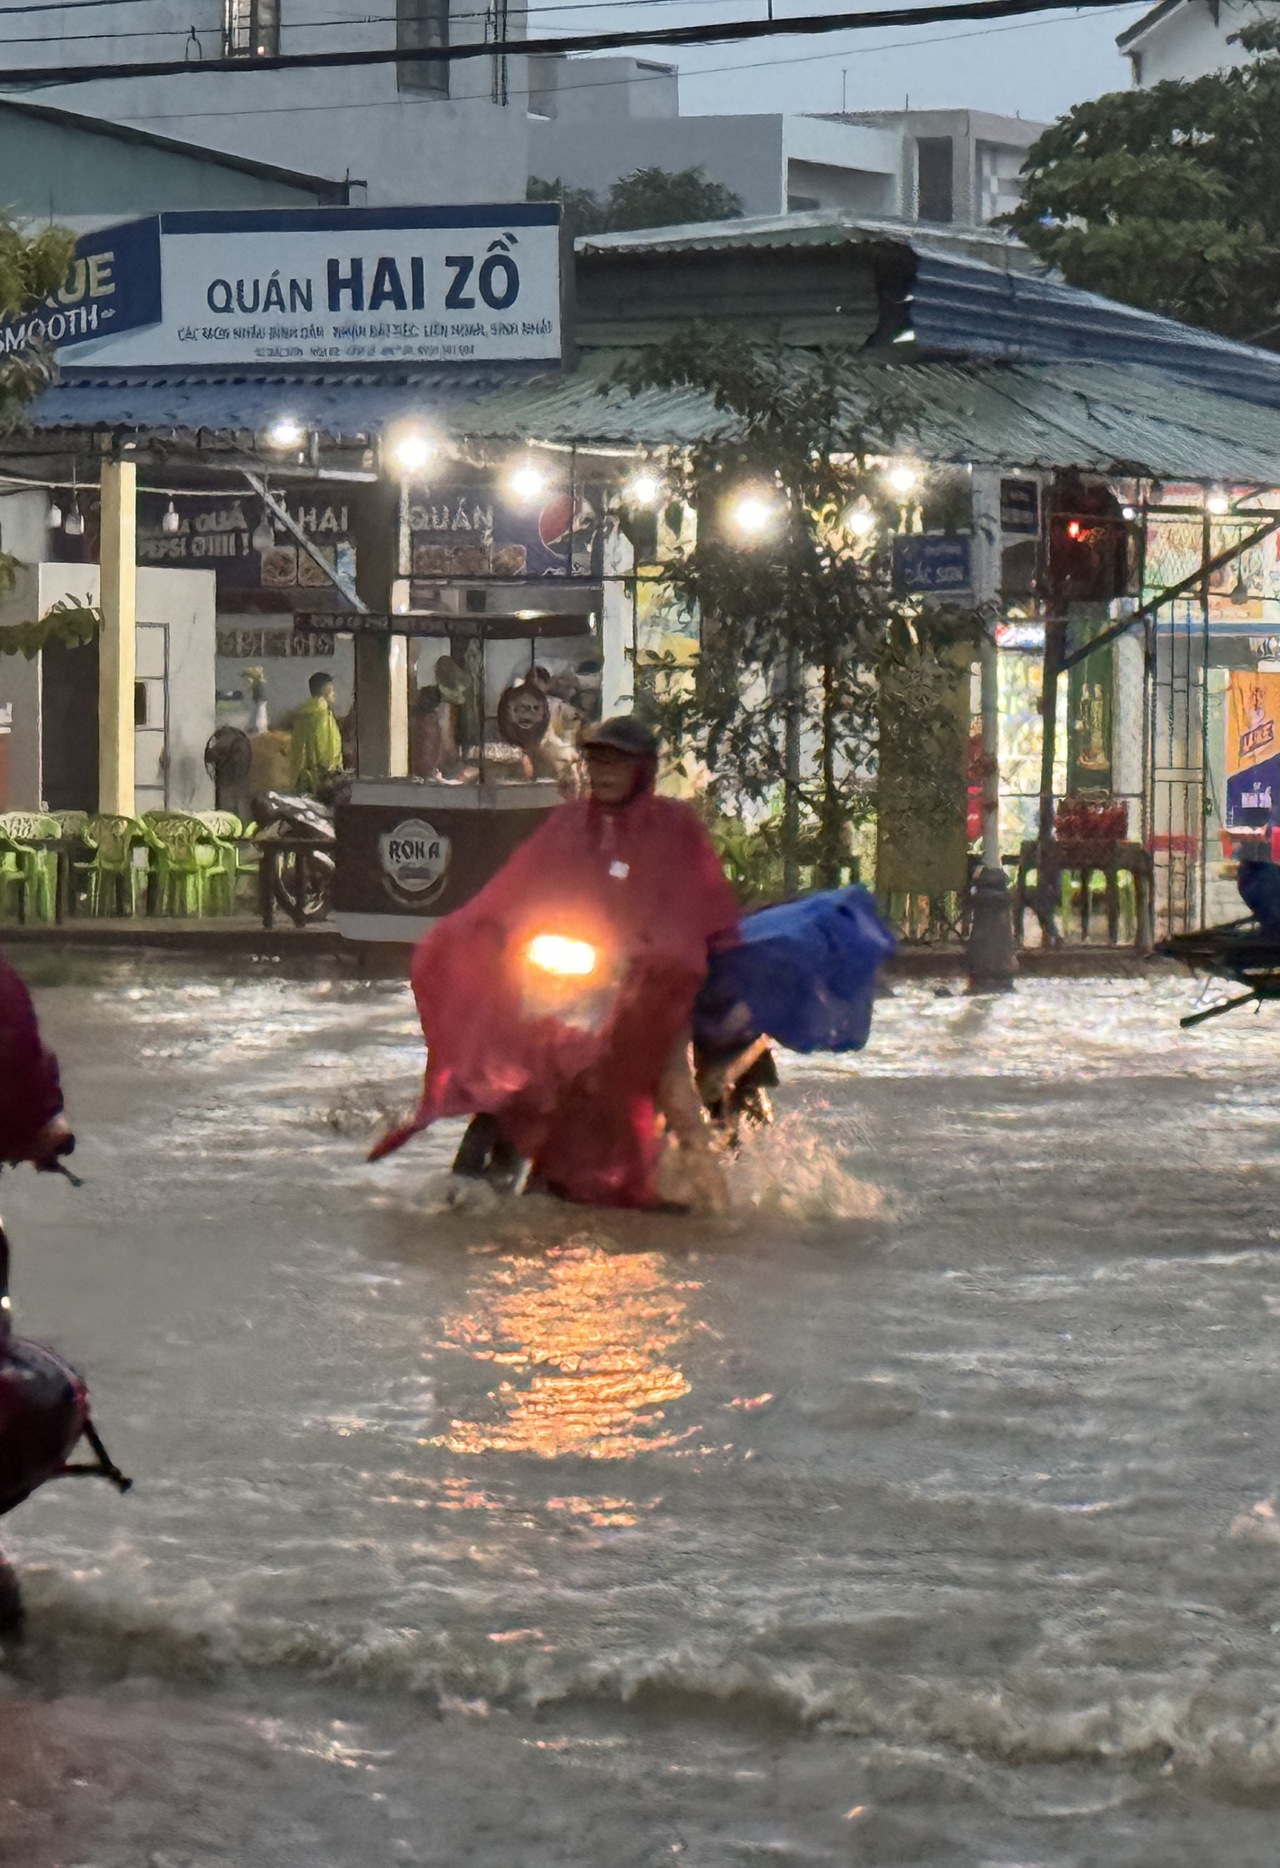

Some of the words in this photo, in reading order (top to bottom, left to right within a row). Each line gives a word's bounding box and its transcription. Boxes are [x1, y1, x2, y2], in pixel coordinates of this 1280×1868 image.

[207, 269, 312, 314] QUÁN
[327, 256, 425, 312] HAI
[445, 232, 520, 310] ZỒ
